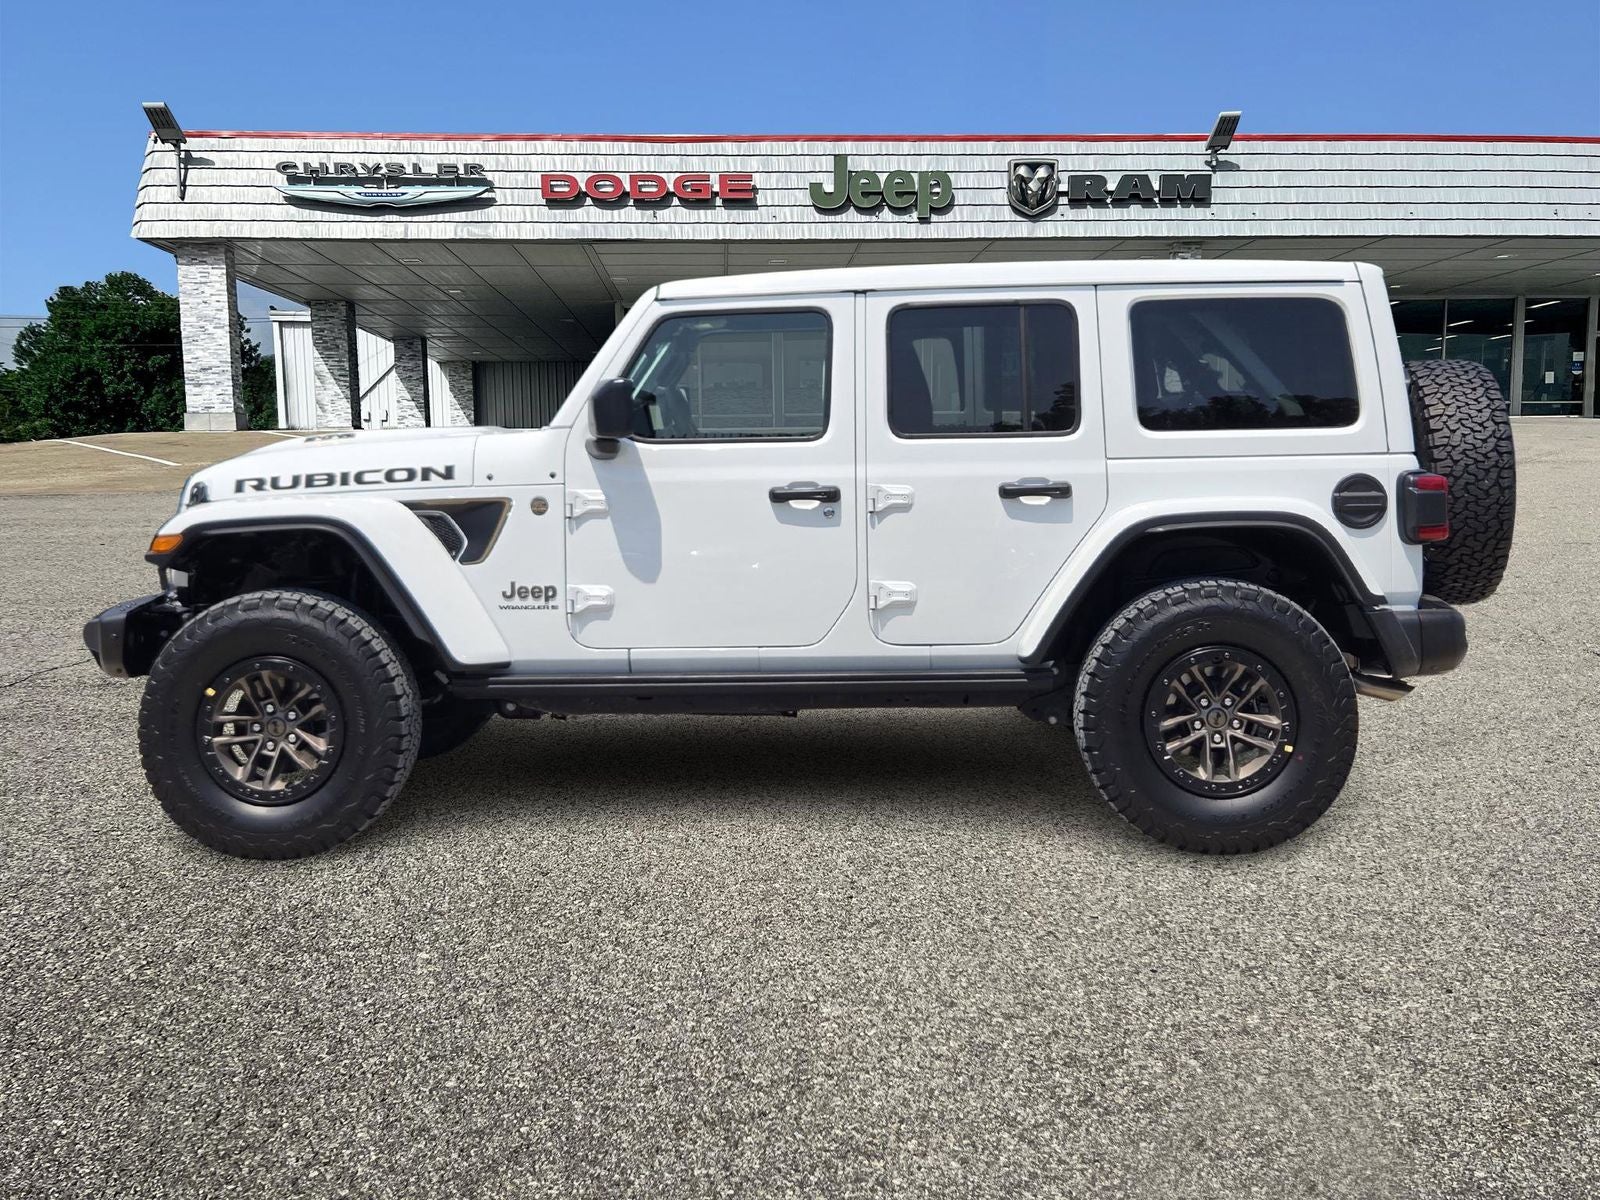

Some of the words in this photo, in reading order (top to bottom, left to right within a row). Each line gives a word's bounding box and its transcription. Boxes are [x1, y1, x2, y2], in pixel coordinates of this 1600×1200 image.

[275, 161, 485, 177] CHRYSLER
[541, 174, 754, 199] DODGE
[809, 155, 953, 219] Jeep
[1067, 174, 1212, 199] RAM
[234, 464, 455, 493] RUBICON
[501, 581, 557, 602] Jeep
